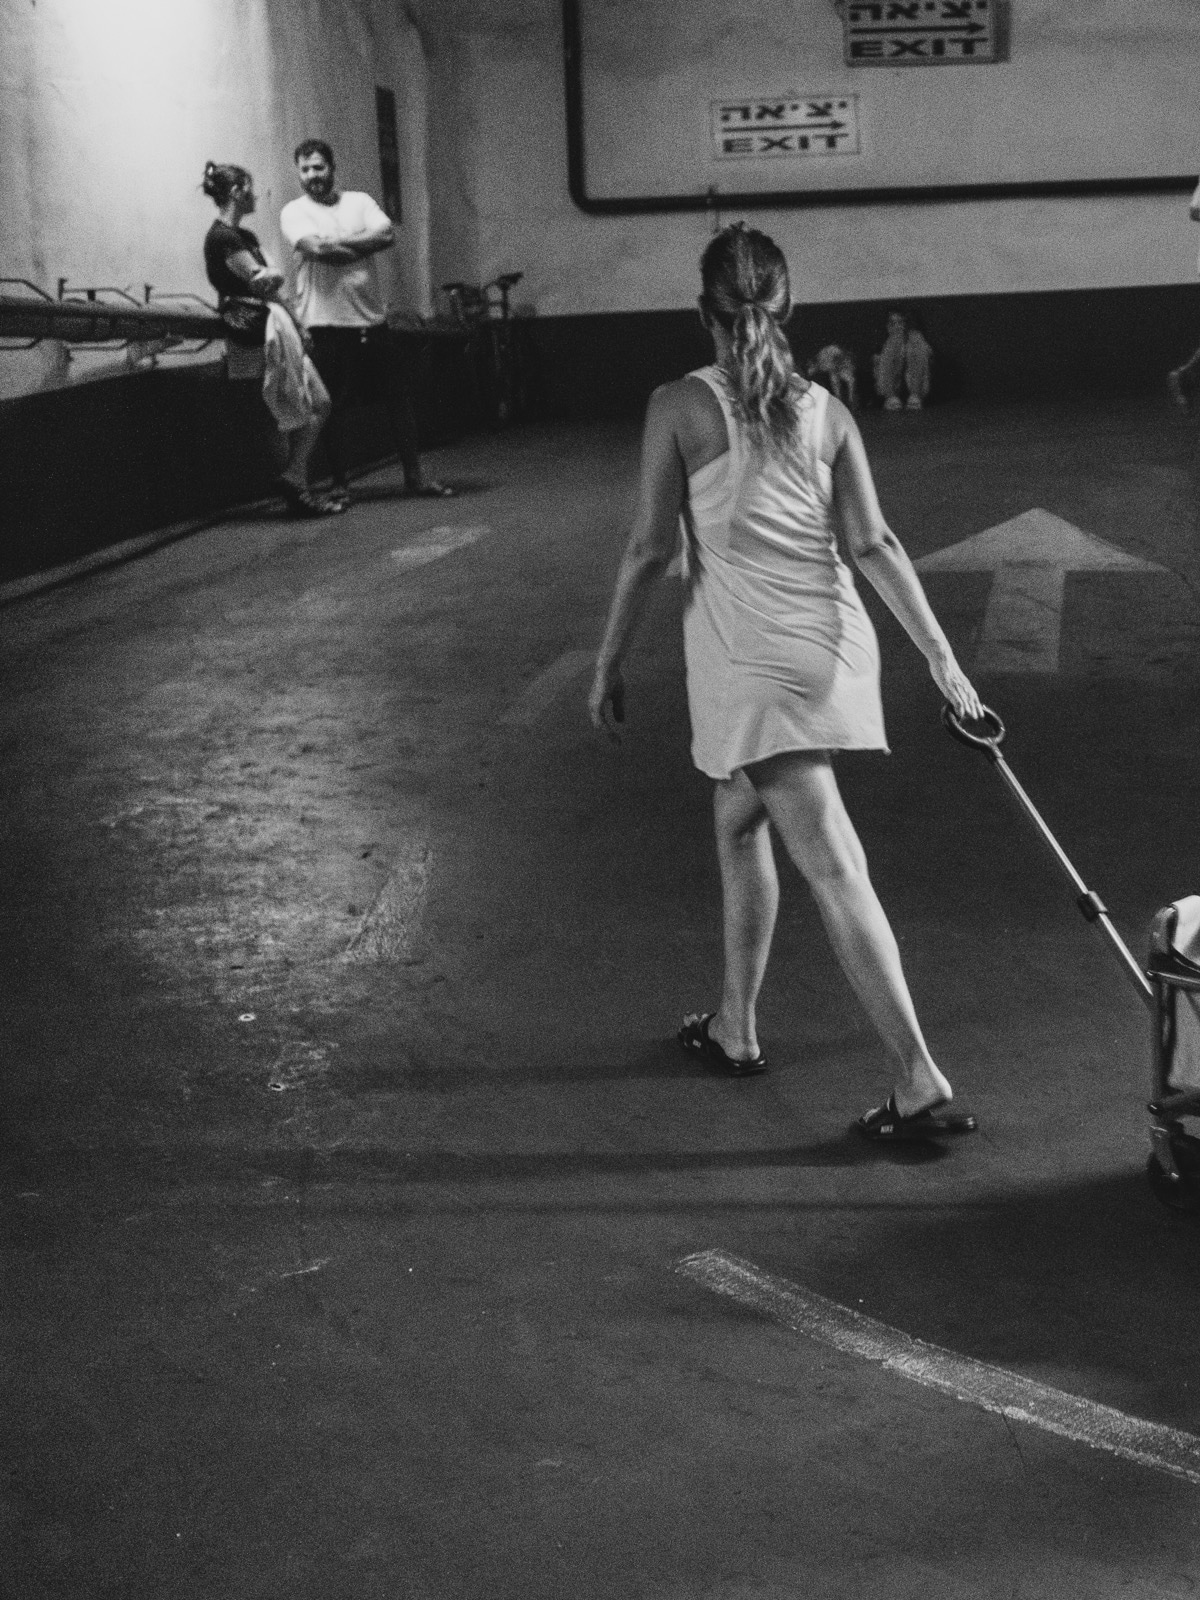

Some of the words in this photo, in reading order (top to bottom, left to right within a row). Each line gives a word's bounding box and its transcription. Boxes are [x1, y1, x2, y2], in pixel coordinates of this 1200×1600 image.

[848, 0, 988, 22] יציאה
[850, 37, 989, 58] EXIT
[719, 100, 848, 123] יציאה
[721, 133, 850, 154] EXIT
